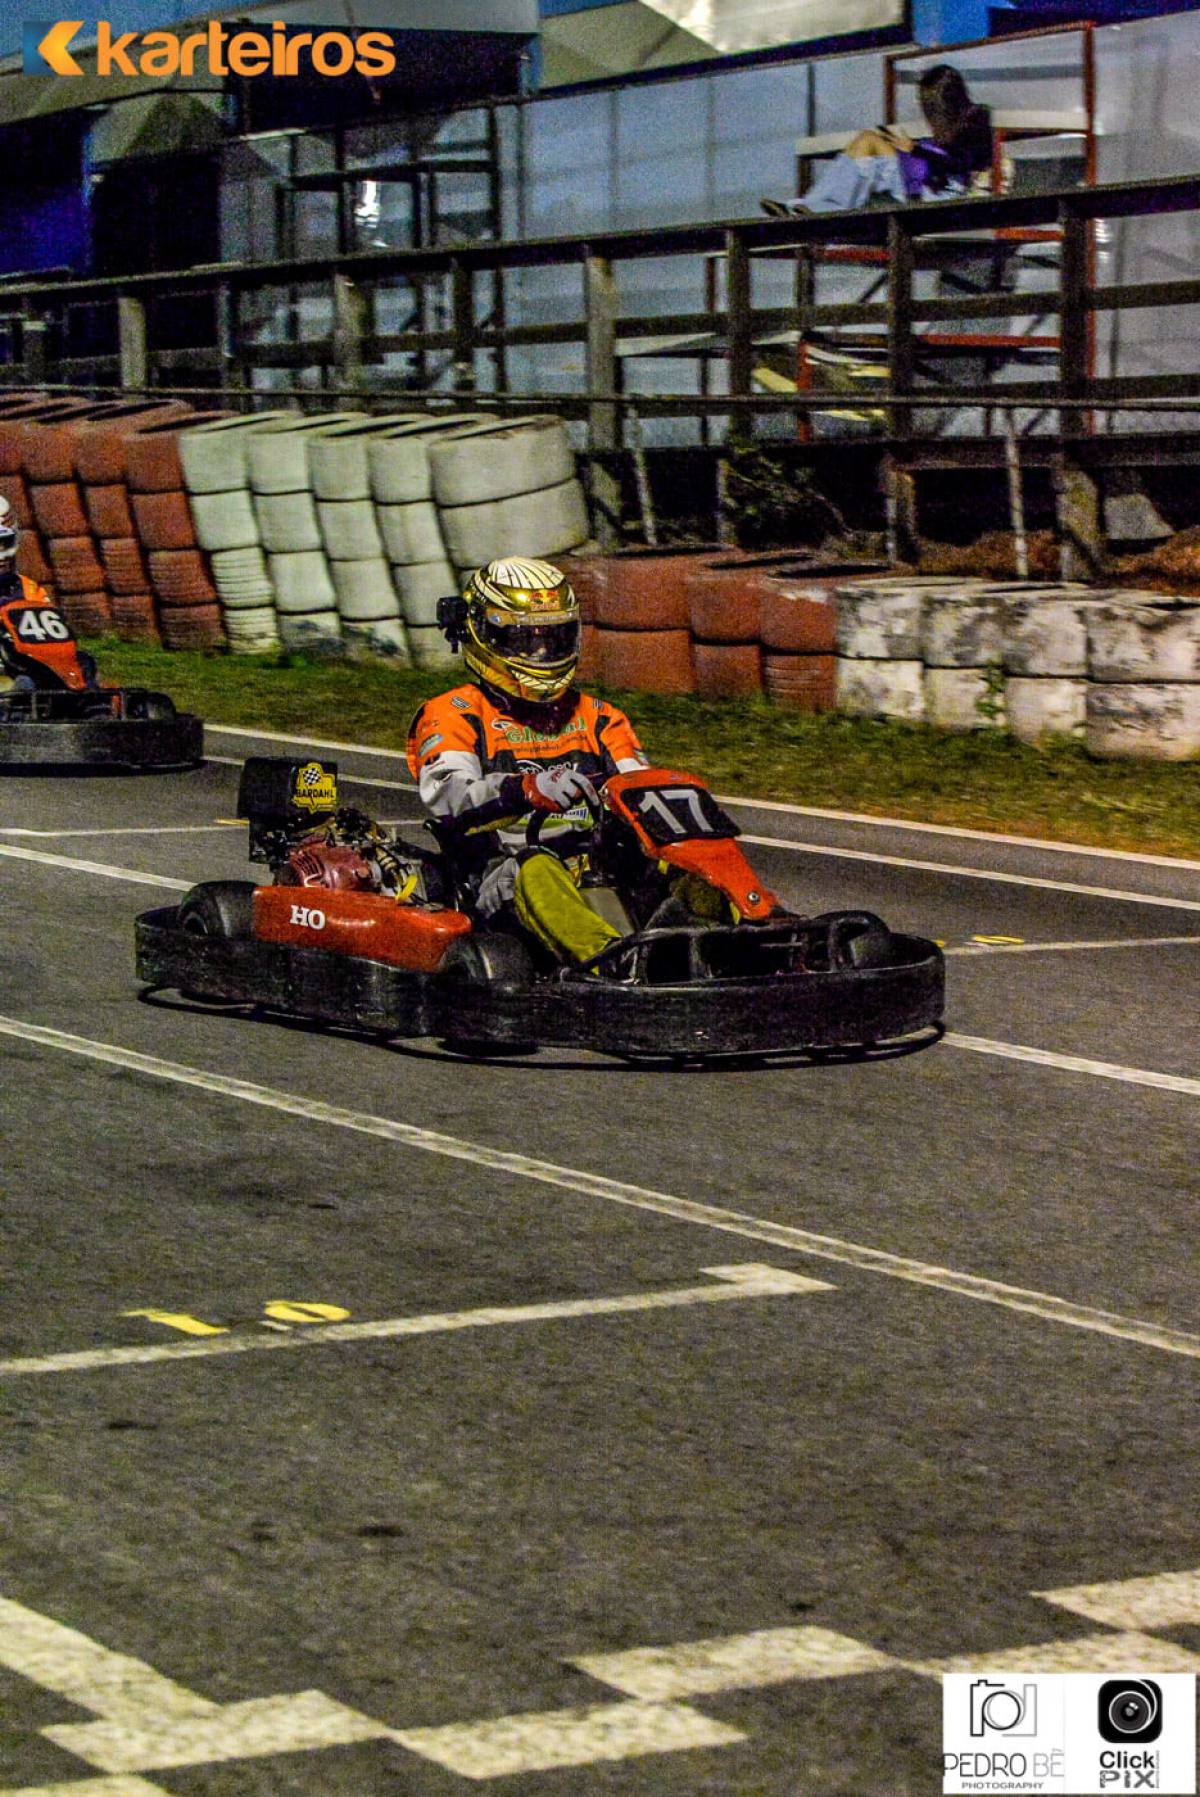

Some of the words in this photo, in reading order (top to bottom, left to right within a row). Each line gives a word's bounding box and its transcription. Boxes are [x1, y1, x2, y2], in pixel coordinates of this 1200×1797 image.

[18, 610, 69, 640] 46
[296, 788, 335, 798] BARDAHL
[638, 788, 714, 835] 17
[289, 904, 326, 930] HO
